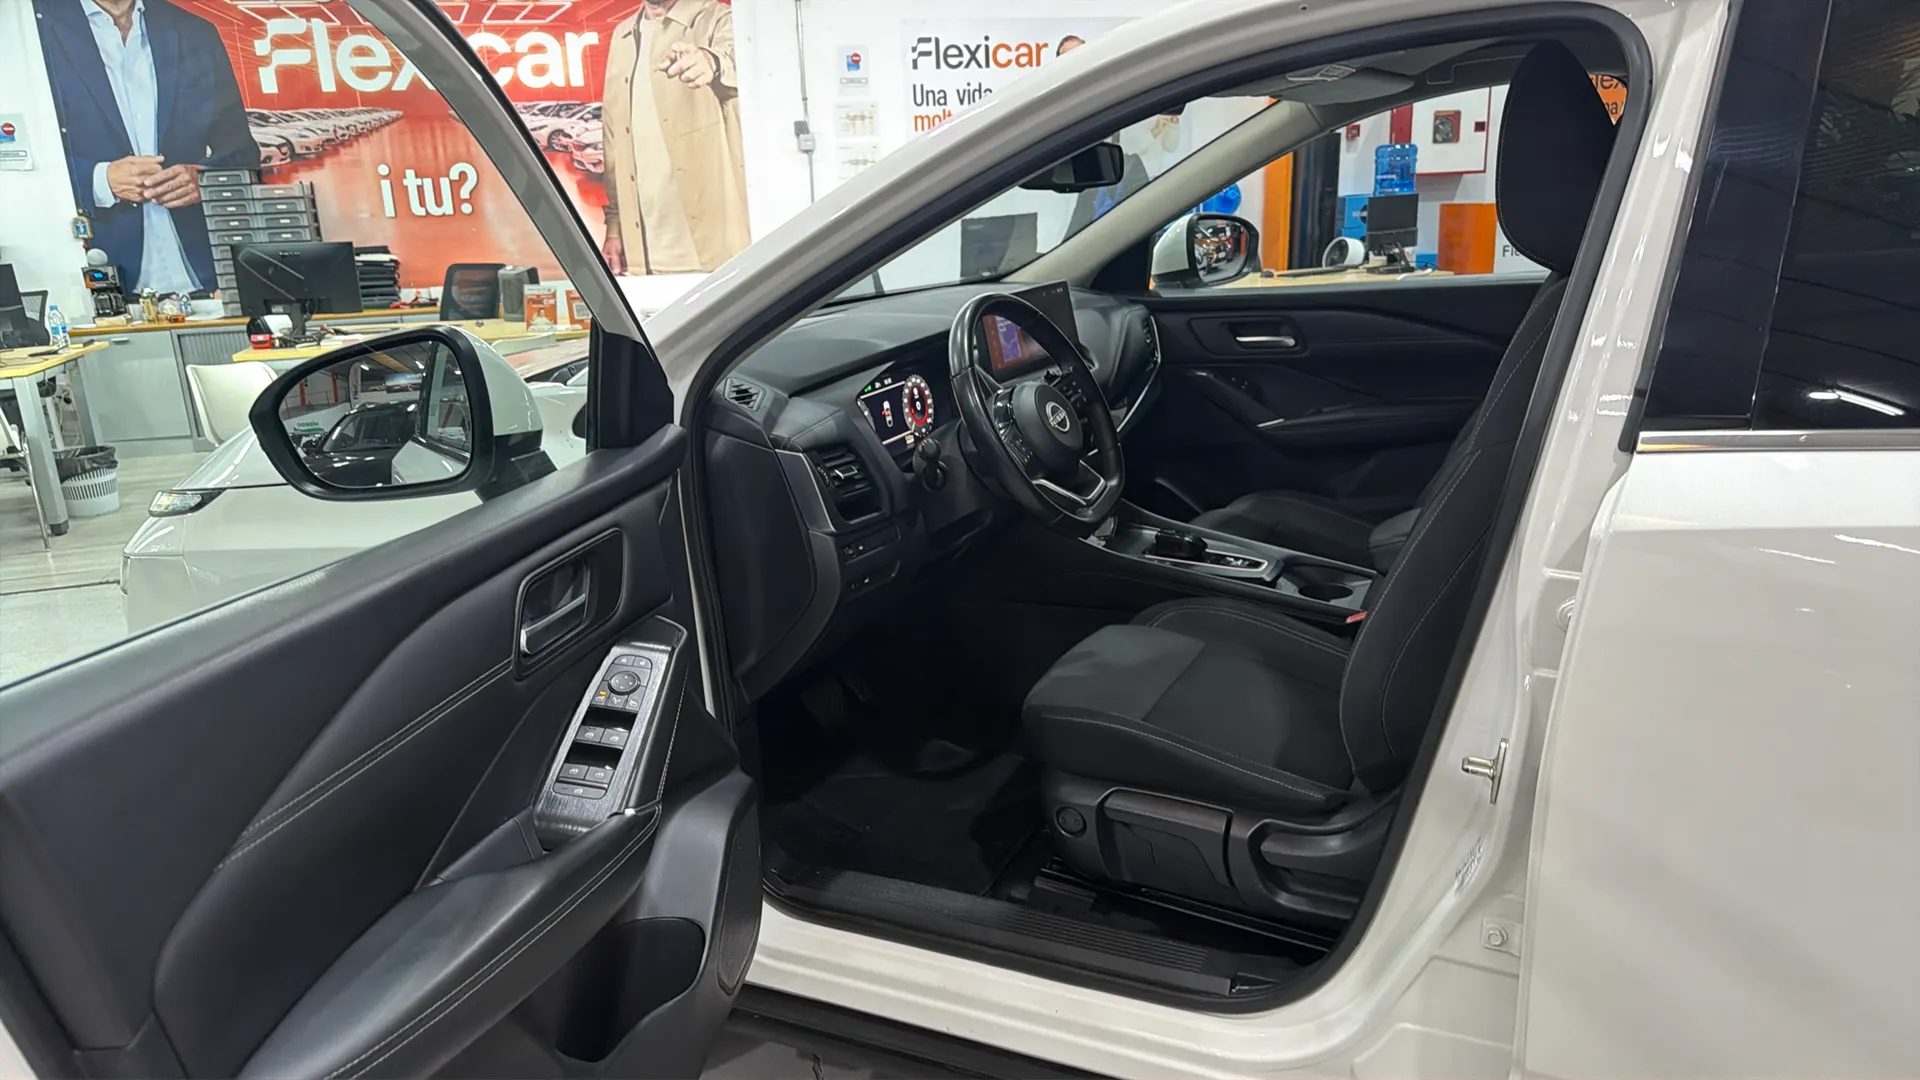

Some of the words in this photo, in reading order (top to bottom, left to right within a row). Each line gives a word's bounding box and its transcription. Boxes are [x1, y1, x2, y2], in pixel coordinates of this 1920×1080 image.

[254, 18, 599, 92] Flexcar
[911, 35, 1049, 70] Flexicar
[913, 83, 948, 107] Una
[377, 164, 397, 218] i
[403, 162, 479, 217] tu?
